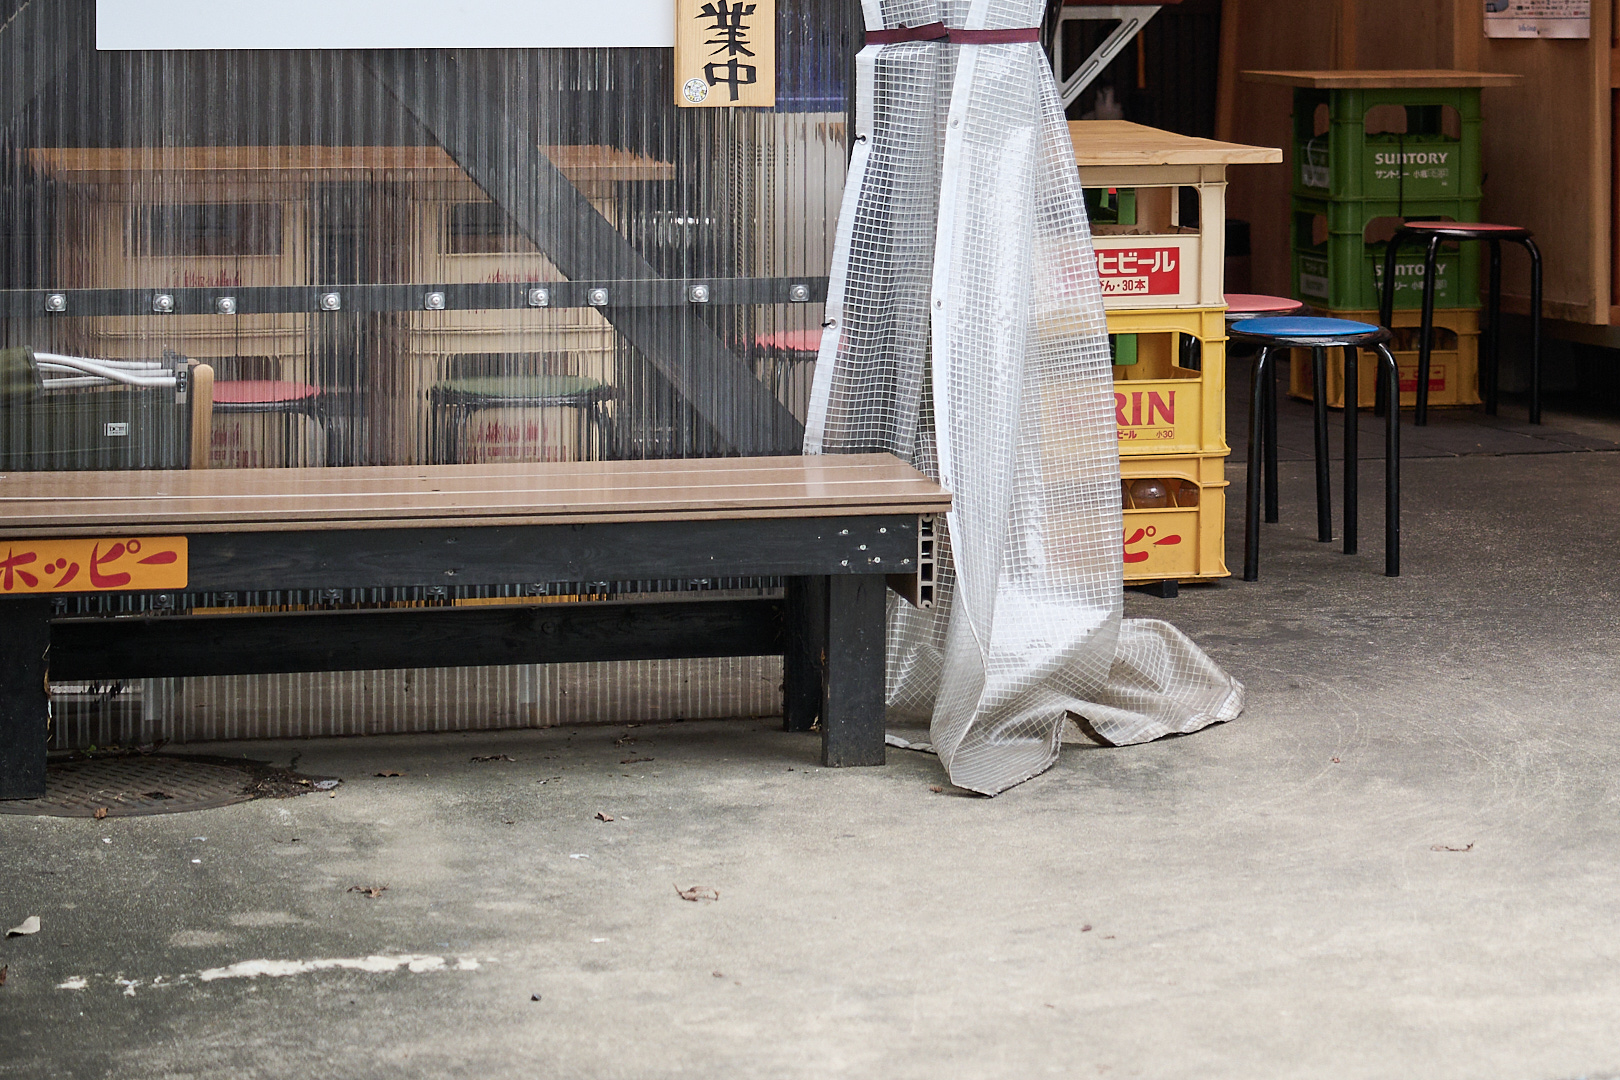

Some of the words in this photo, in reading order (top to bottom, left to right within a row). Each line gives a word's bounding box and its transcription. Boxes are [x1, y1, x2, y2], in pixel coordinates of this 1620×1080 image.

[1375, 152, 1449, 165] SUNTORY
[1375, 170, 1410, 179] サントリー
[1097, 251, 1176, 274] ヒビール
[1375, 264, 1447, 276] SNTOY
[1115, 390, 1176, 427] RIN
[1156, 430, 1174, 439] 小30
[1123, 526, 1182, 564] ピー
[0, 539, 178, 591] ホッピー
